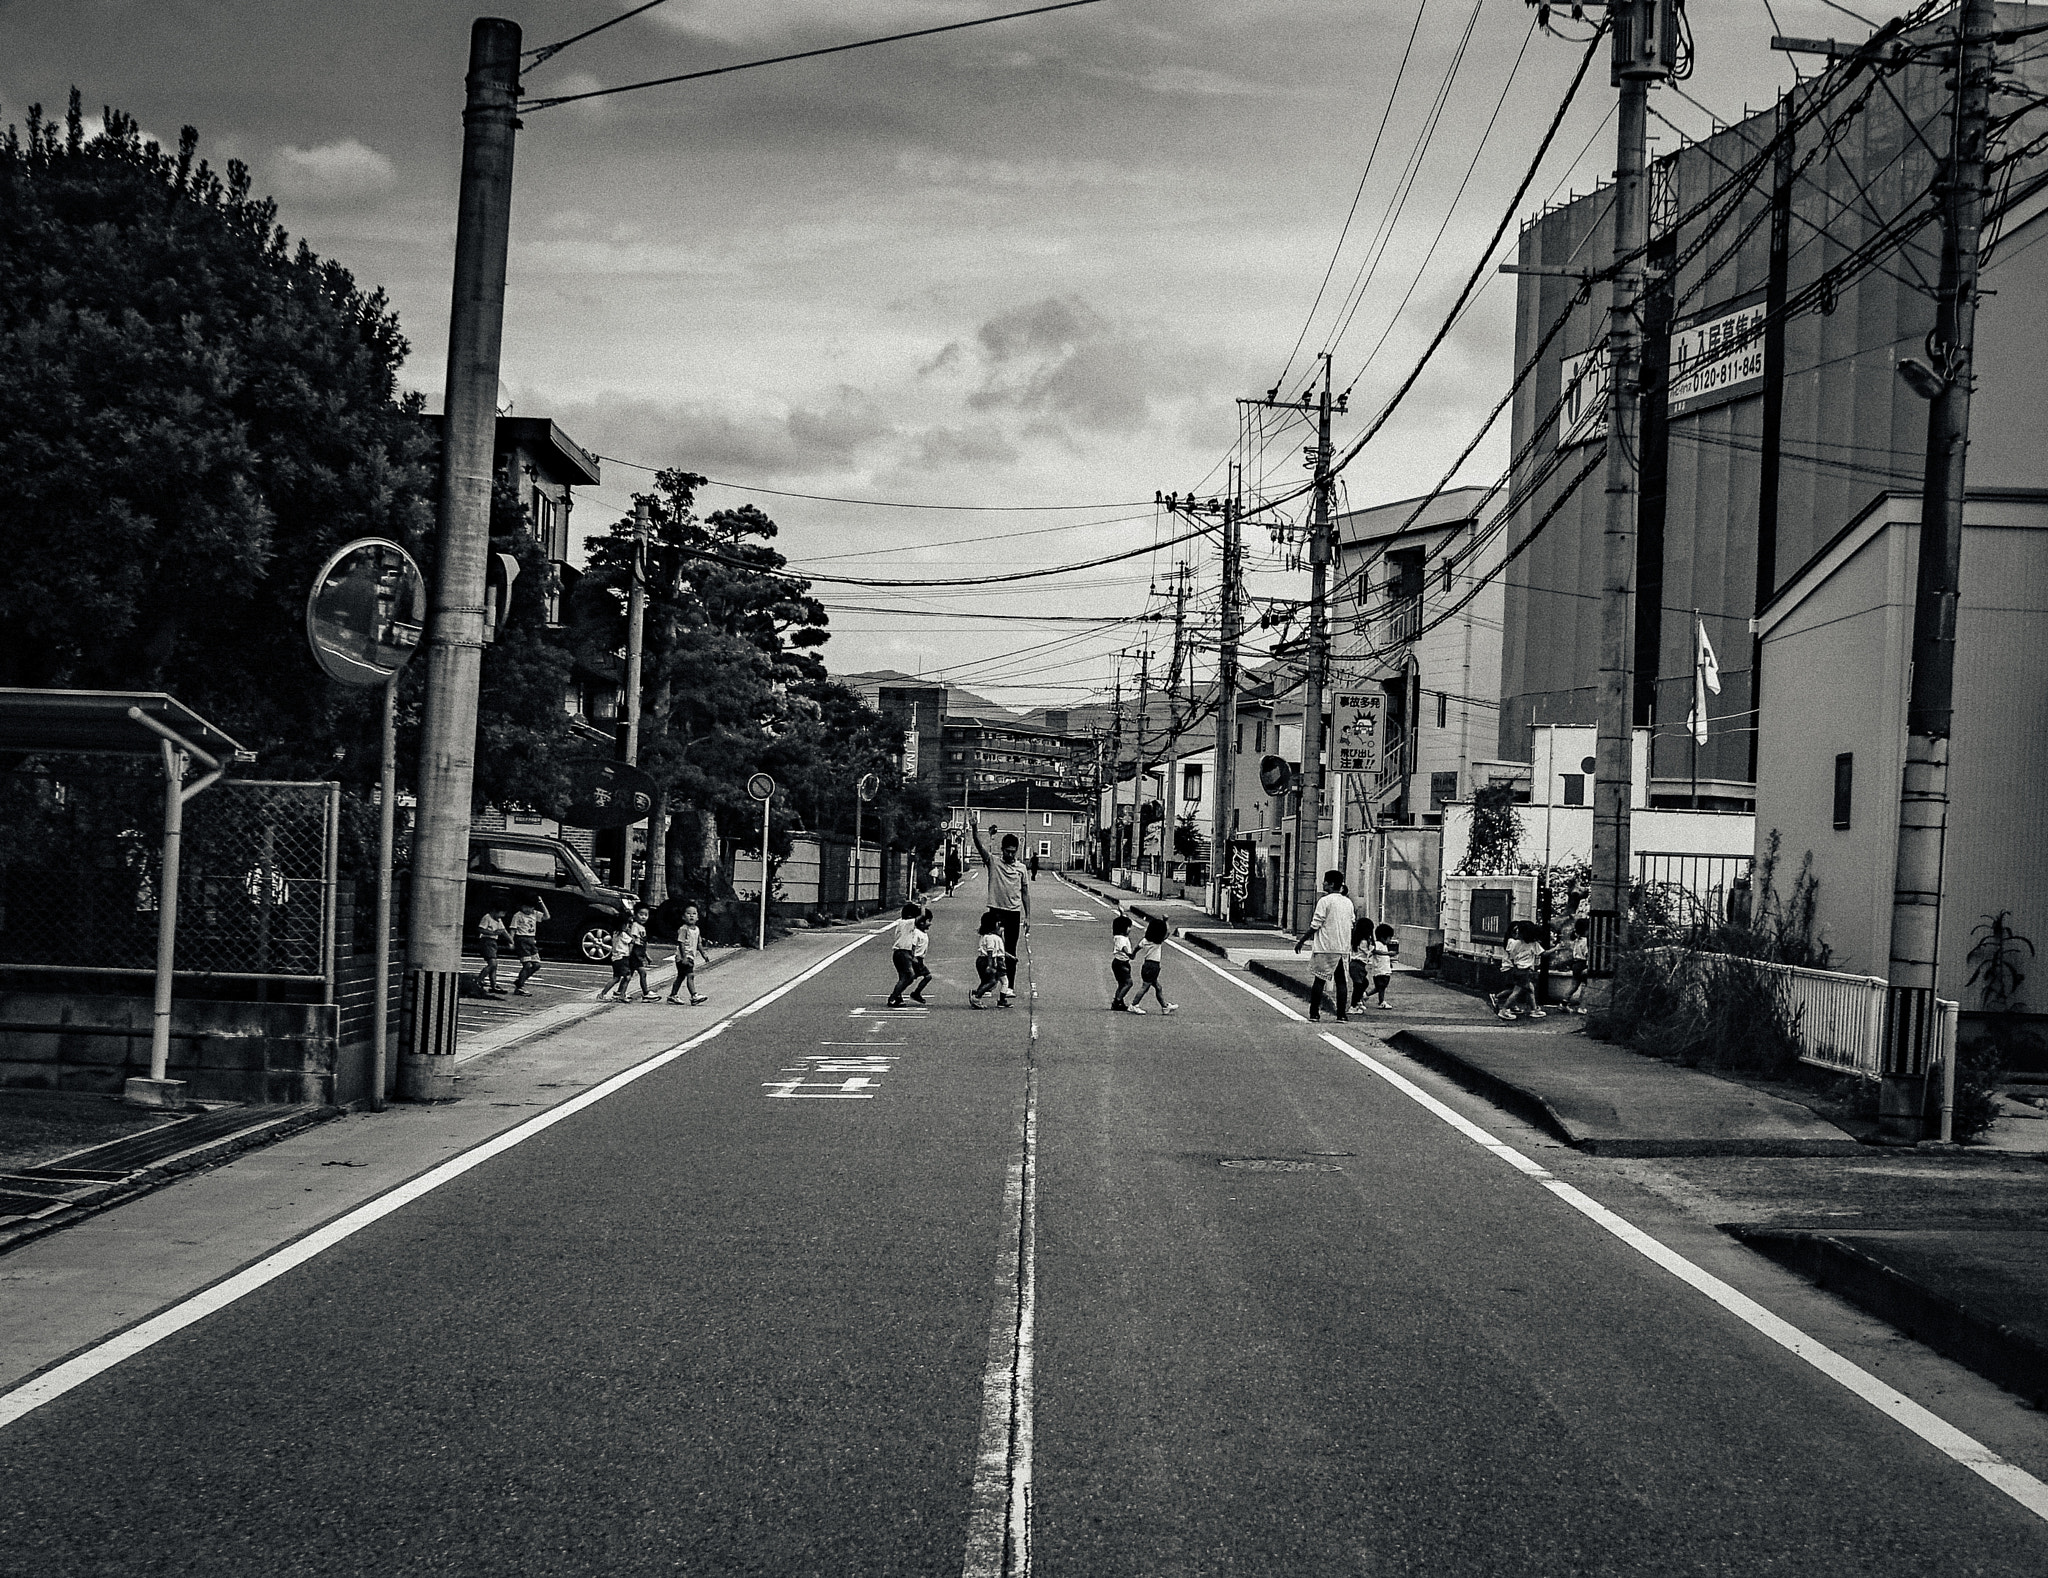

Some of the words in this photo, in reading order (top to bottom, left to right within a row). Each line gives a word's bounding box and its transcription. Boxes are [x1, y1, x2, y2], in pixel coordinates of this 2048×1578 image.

[1340, 696, 1380, 708] 事故多発
[1340, 748, 1375, 758] 飛び出し
